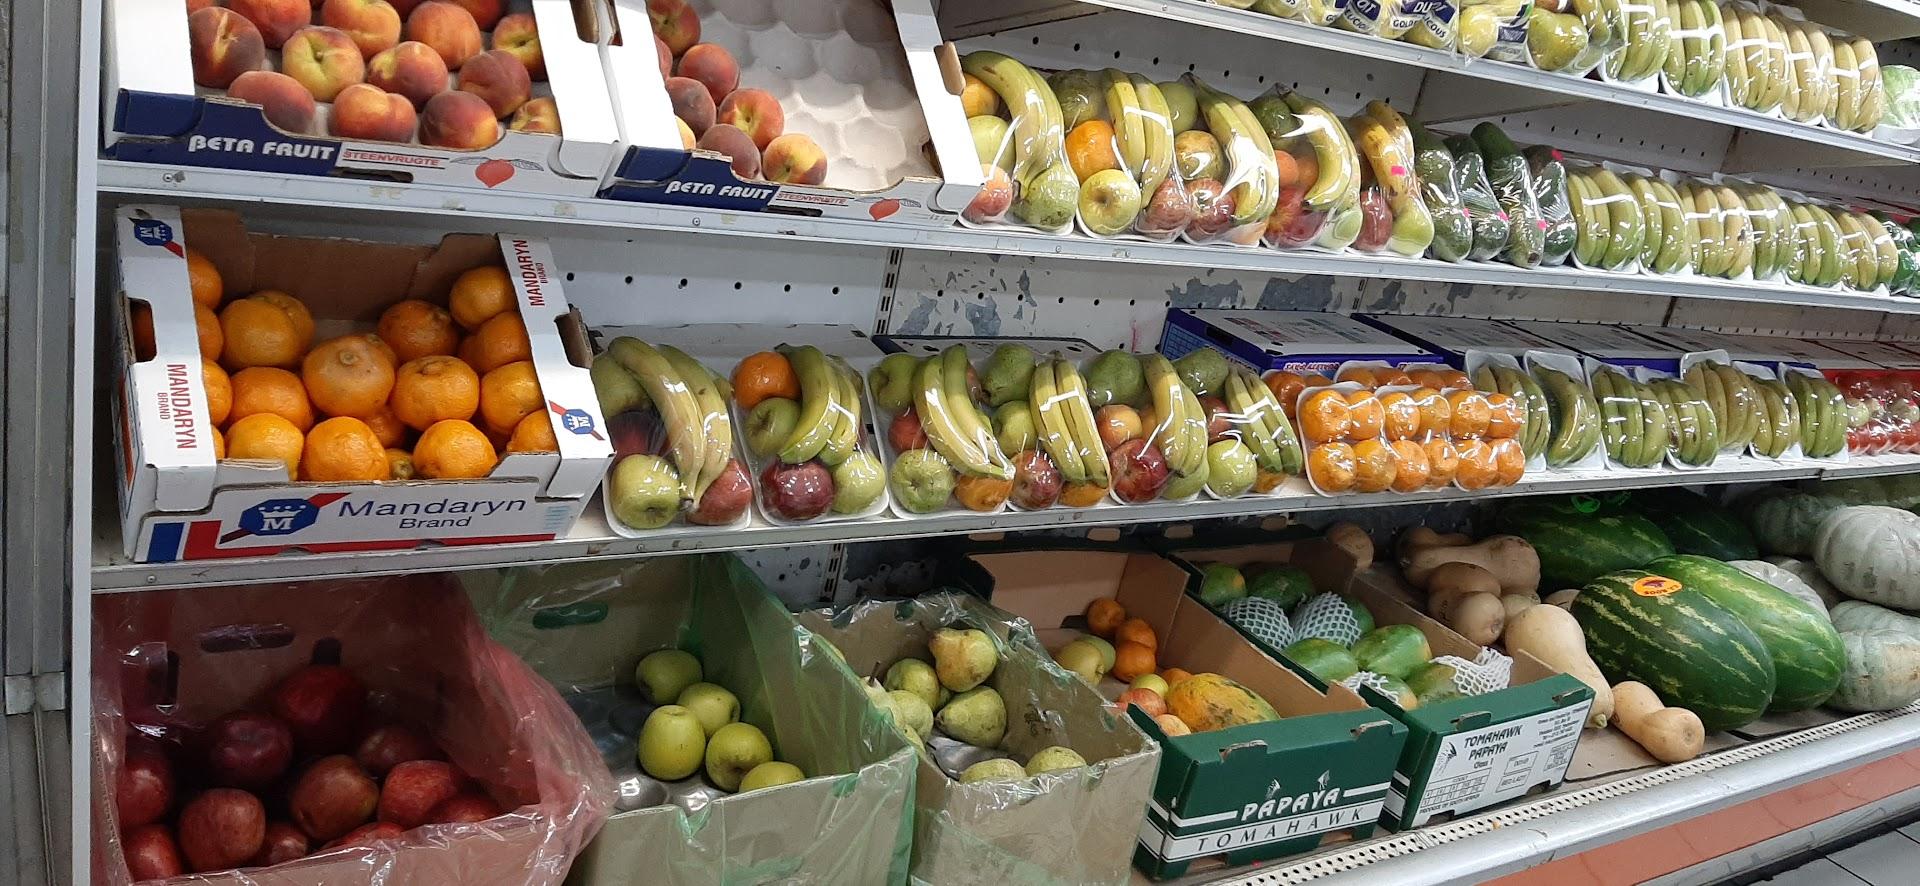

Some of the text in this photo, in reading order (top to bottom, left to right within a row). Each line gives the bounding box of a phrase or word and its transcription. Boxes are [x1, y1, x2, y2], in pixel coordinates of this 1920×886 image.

[188, 134, 439, 168] BETA FRUIT STEENVRUGTE
[665, 180, 715, 196] BETA
[718, 185, 773, 200] FRUIT
[512, 239, 545, 307] MANDARYN
[157, 392, 171, 420] BRAND
[166, 363, 198, 449] MANDARYN
[338, 500, 526, 520] Mandaryn
[399, 515, 472, 530] Brand
[261, 516, 292, 532] M
[1464, 725, 1522, 748] TOMAHAWK
[1468, 741, 1508, 760] PAPAYA
[1240, 787, 1341, 822] PAPAYA
[1197, 806, 1364, 852] TOMAHAWK
